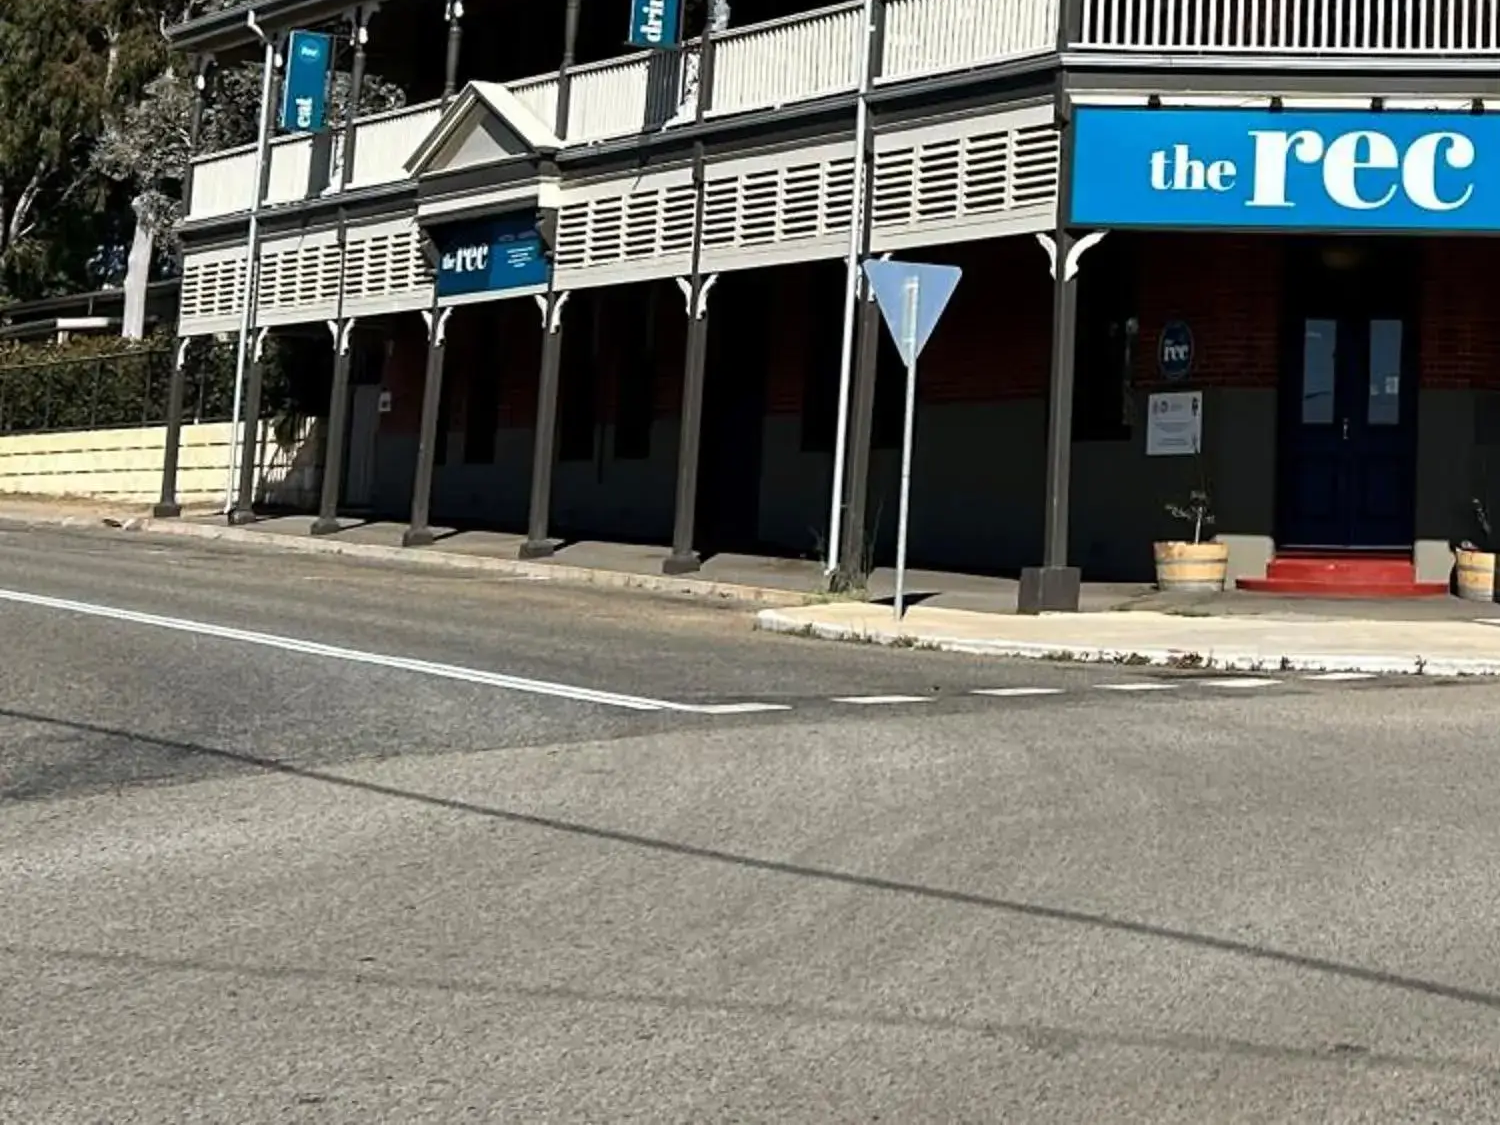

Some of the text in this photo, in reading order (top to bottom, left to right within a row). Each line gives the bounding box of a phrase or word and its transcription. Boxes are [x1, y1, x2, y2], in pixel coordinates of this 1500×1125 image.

[1149, 129, 1476, 212] the rec
[455, 243, 489, 273] rec
